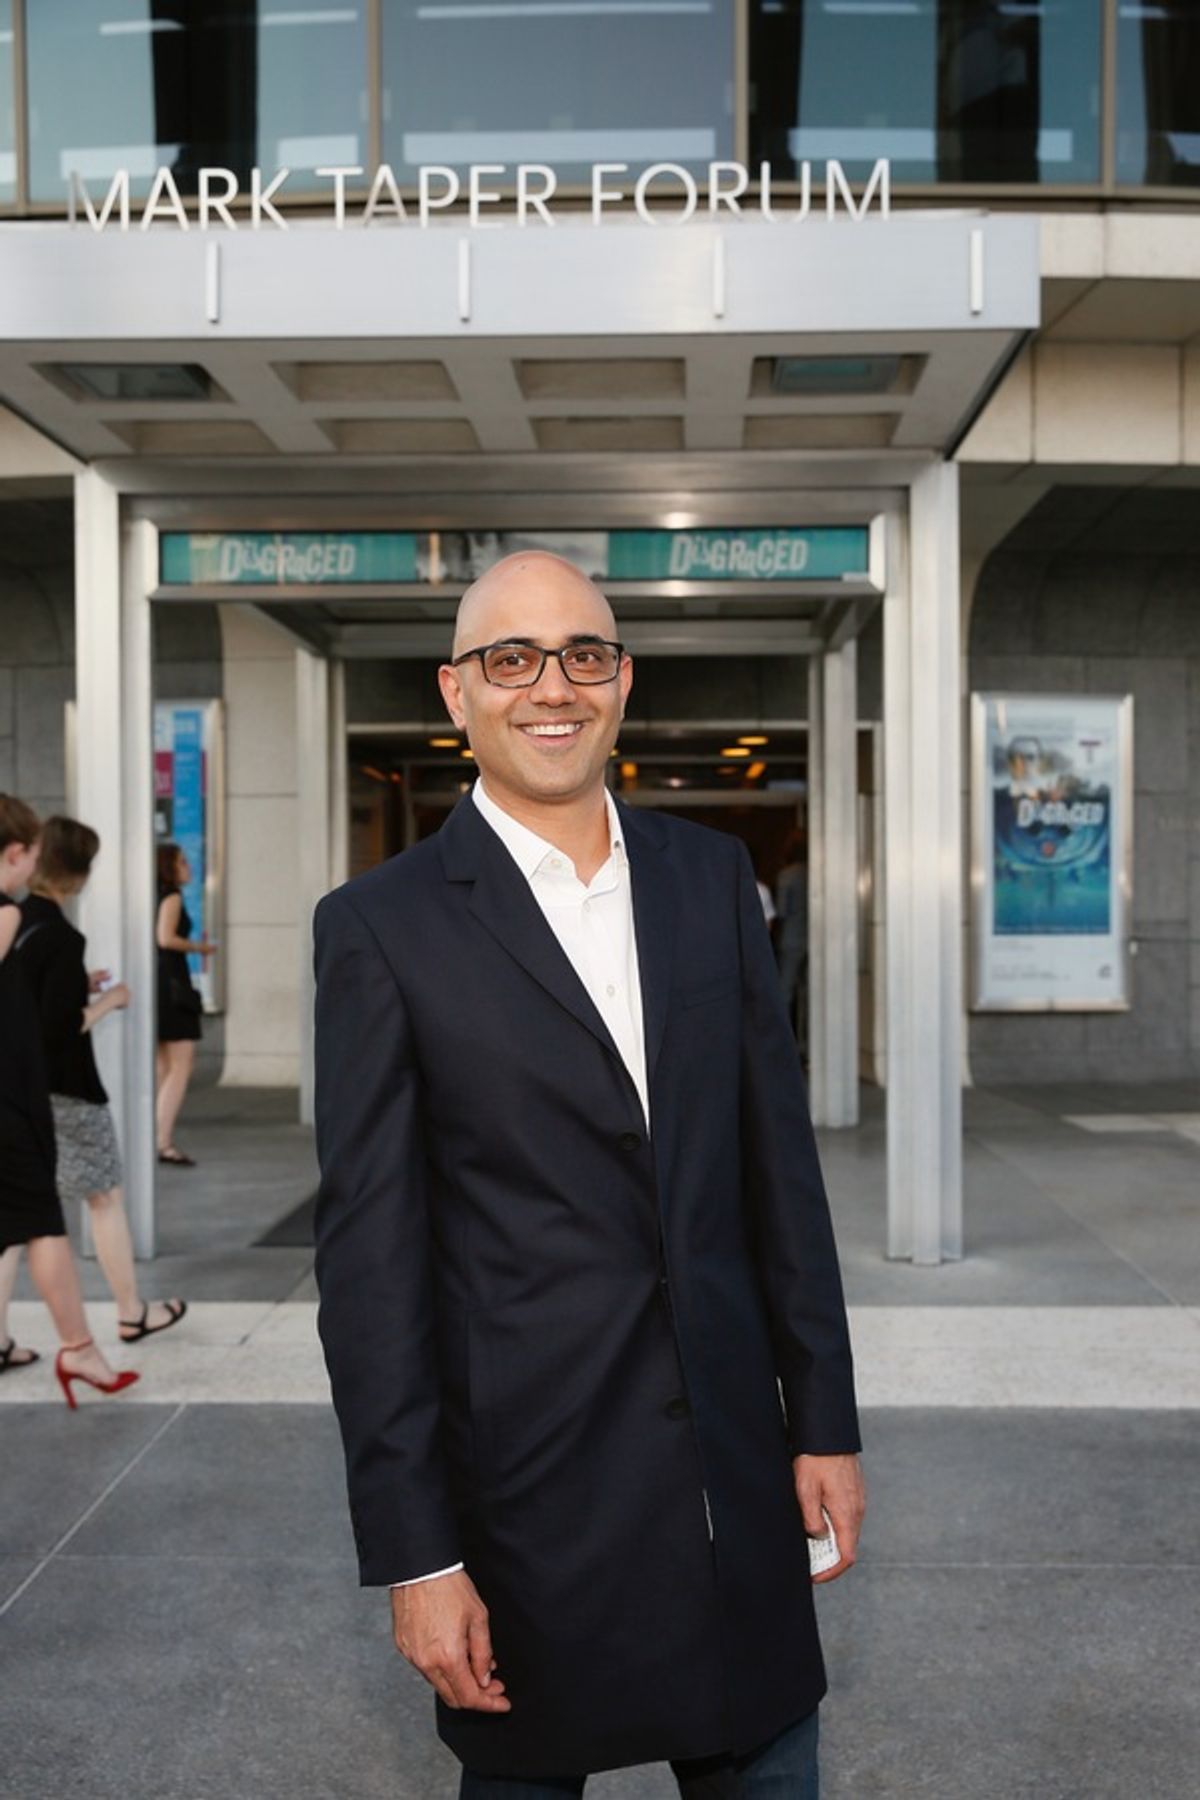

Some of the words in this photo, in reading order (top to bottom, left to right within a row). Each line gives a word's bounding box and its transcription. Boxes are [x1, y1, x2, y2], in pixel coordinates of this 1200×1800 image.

[68, 165, 290, 232] MARK
[315, 164, 558, 230] TAPER
[591, 157, 892, 226] FORUM
